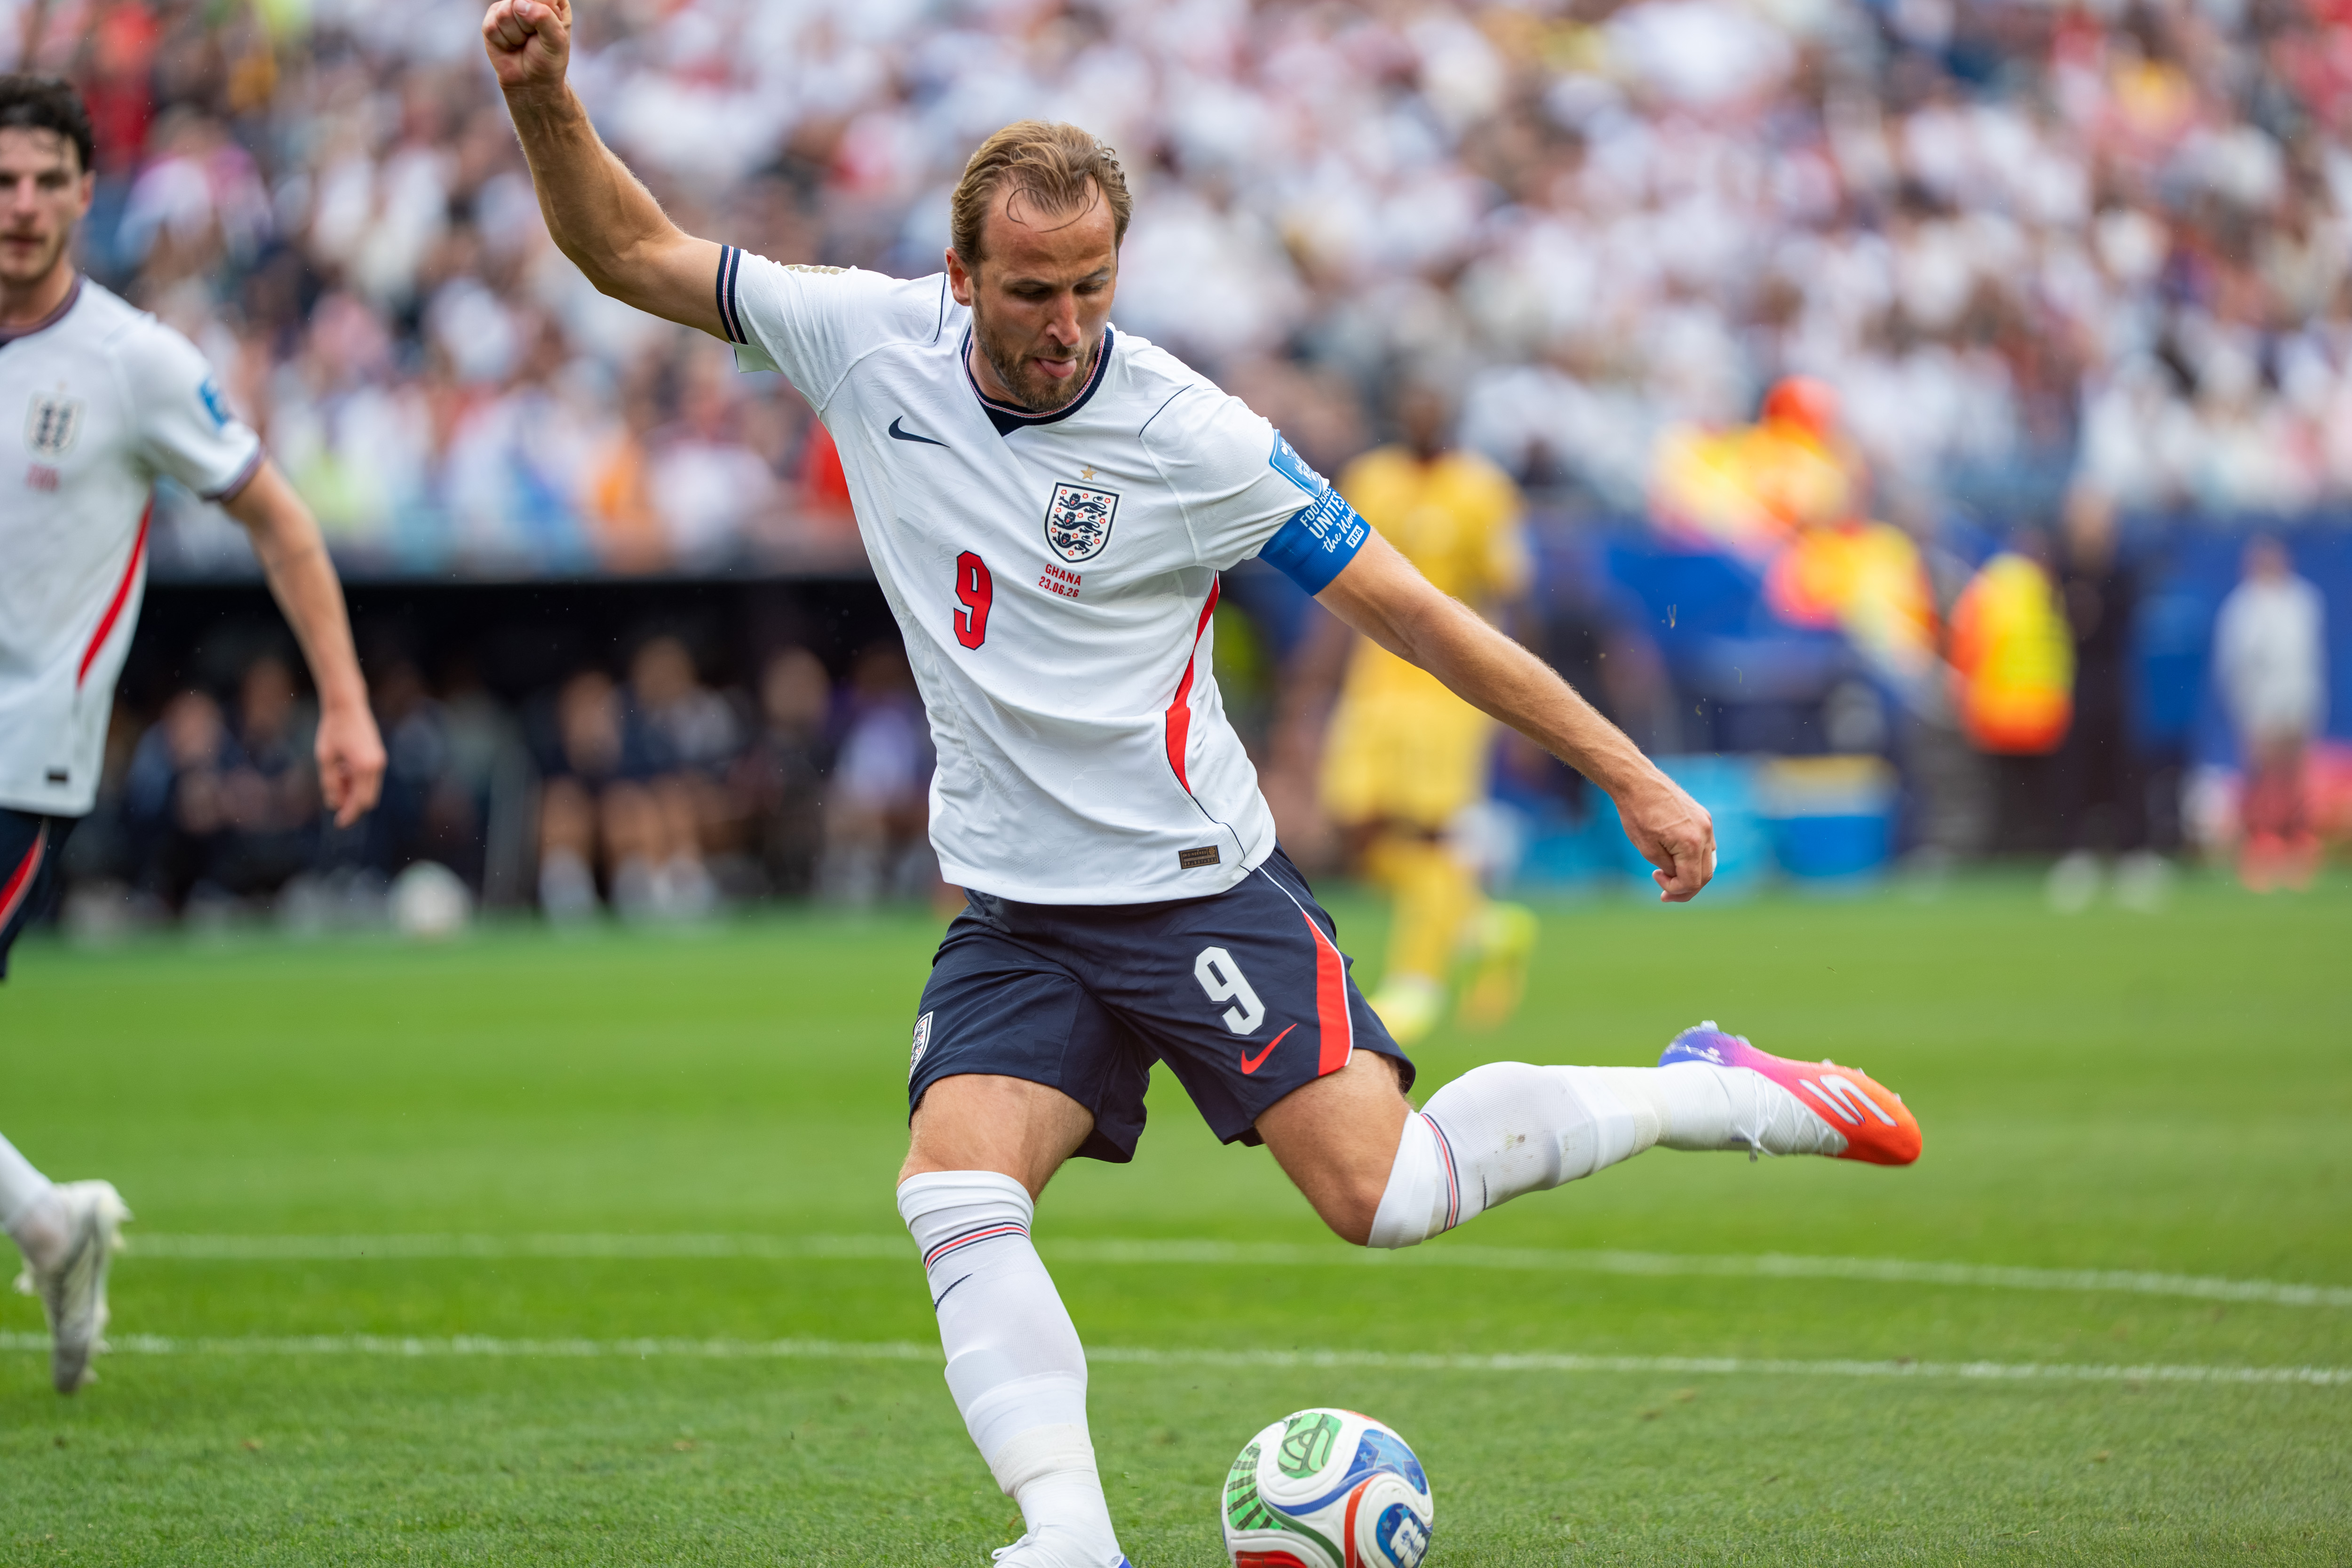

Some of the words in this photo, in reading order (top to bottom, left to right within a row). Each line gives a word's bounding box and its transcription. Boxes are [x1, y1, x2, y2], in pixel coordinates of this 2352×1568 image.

[1308, 491, 1345, 539] UNITES
[1322, 533, 1342, 553] the
[1336, 503, 1358, 534] World
[1348, 527, 1363, 546] FIFA
[1039, 576, 1080, 597] 23.06.26
[1045, 564, 1081, 586] GHANA
[953, 550, 993, 651] 9
[1193, 946, 1266, 1035] 9
